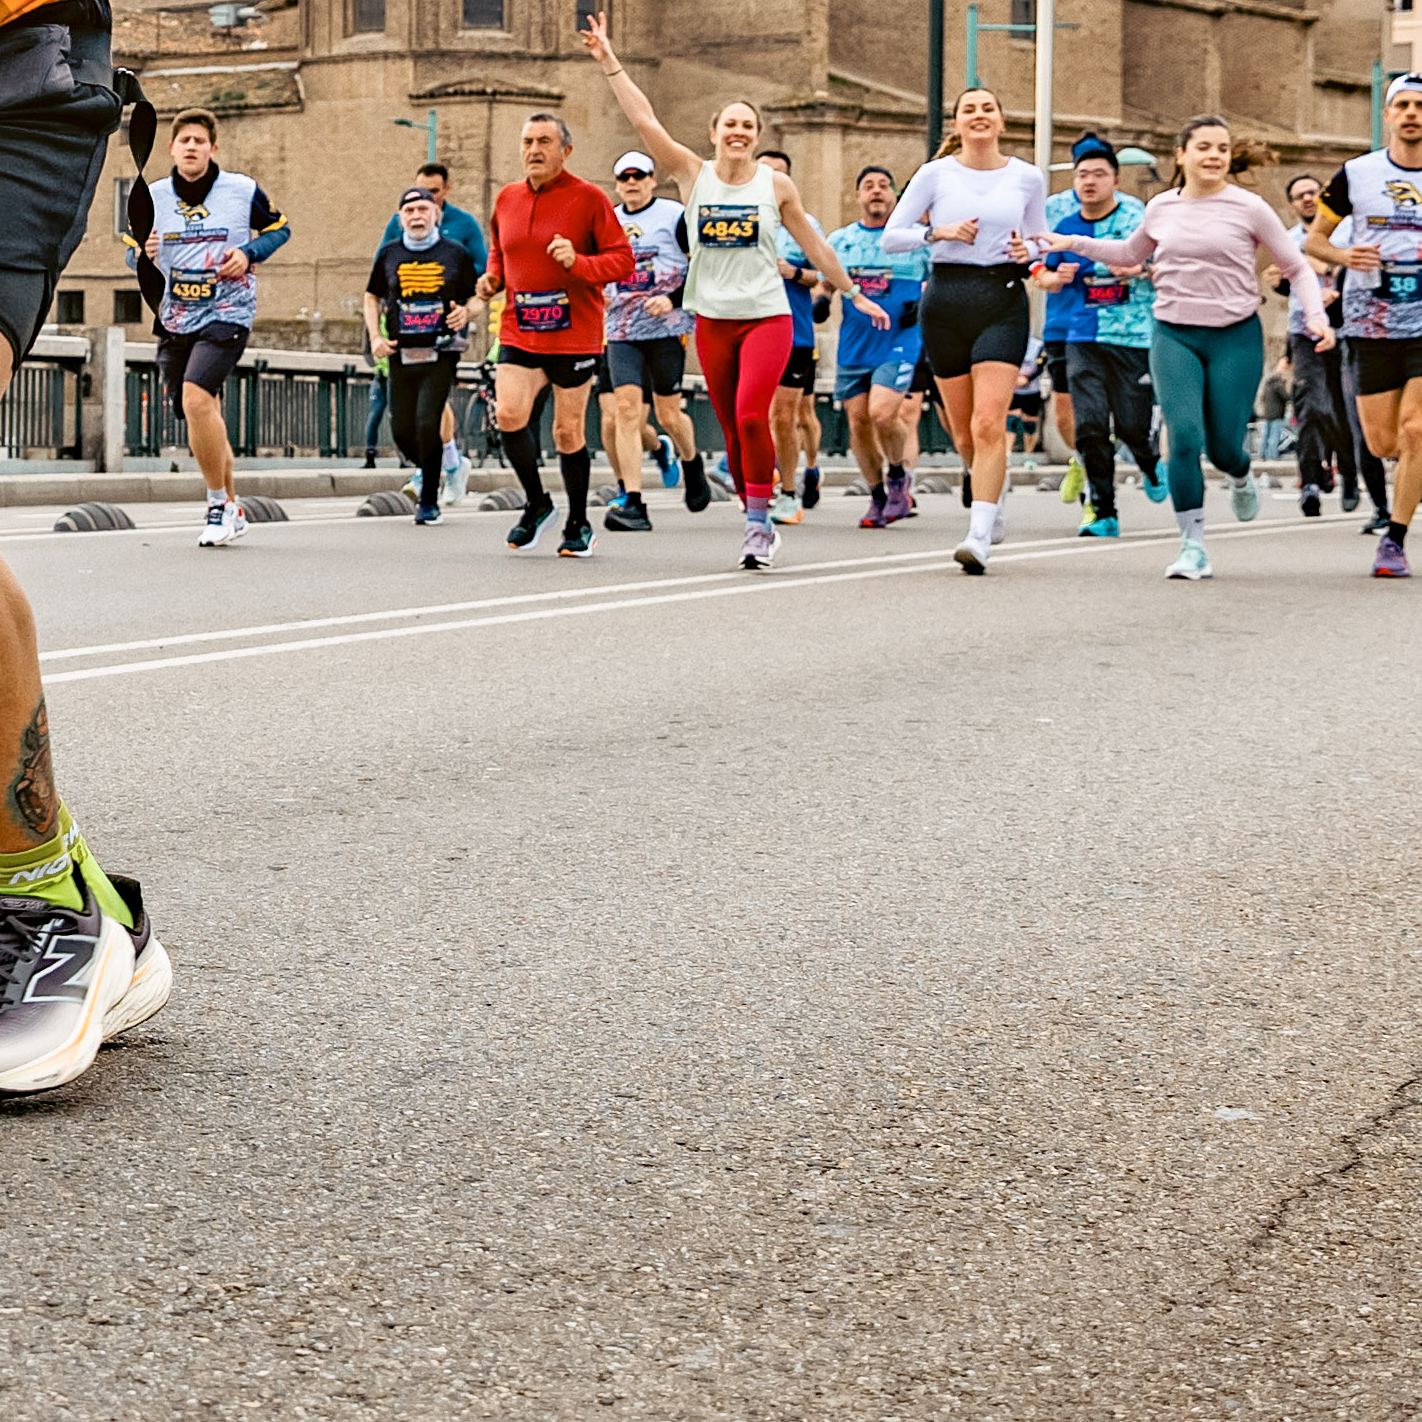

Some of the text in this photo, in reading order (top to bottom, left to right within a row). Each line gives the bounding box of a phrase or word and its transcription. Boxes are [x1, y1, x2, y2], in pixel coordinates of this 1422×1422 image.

[702, 221, 754, 237] 4843
[172, 283, 212, 298] 4305
[1389, 276, 1418, 293] 38
[521, 306, 563, 321] 2970
